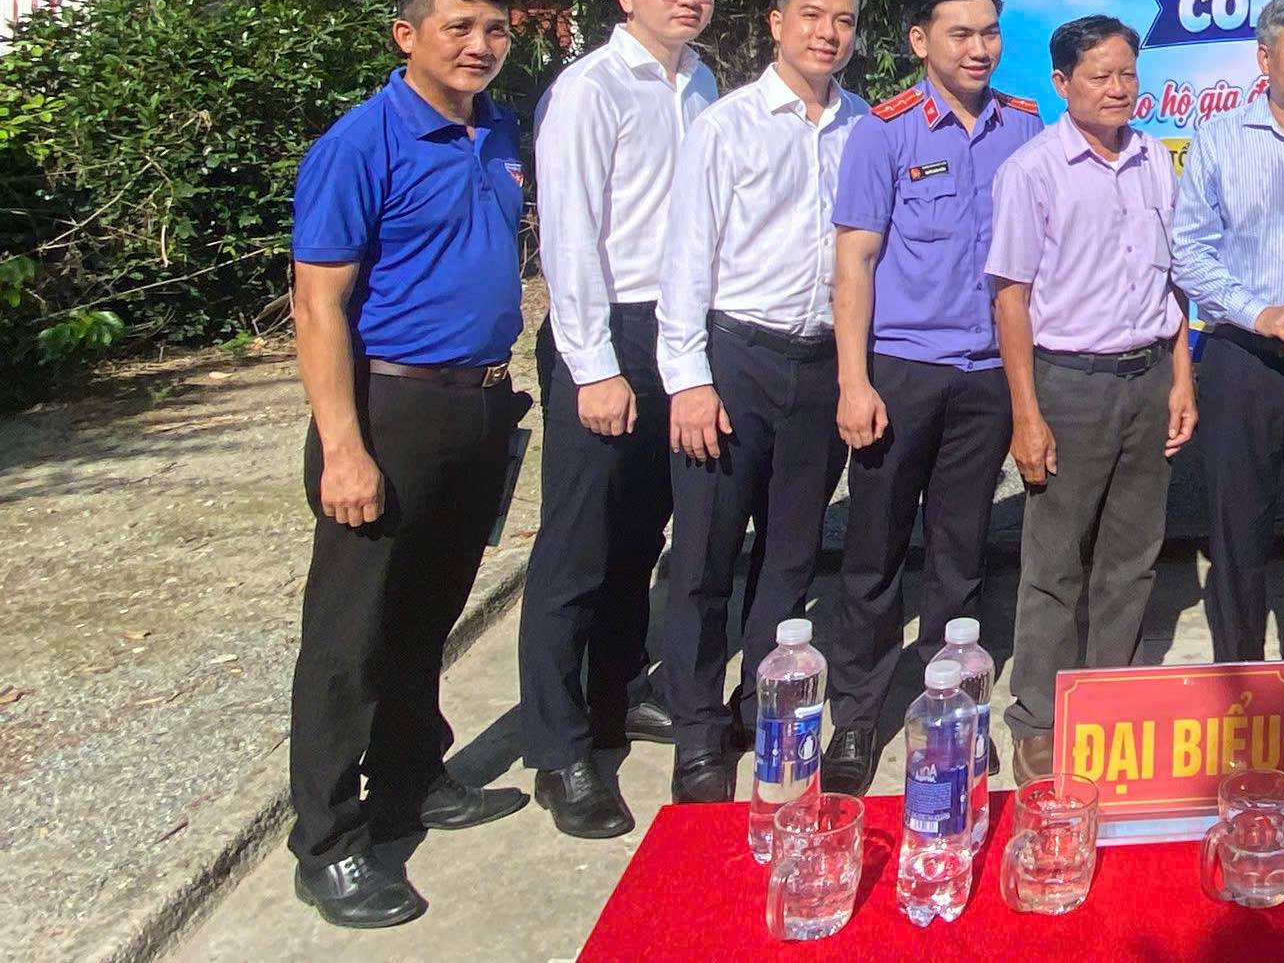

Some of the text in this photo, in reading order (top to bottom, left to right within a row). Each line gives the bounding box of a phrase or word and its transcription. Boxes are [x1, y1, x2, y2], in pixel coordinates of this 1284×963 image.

[1160, 83, 1195, 123] hộ
[1072, 692, 1282, 794] ĐẠI BIỂU
